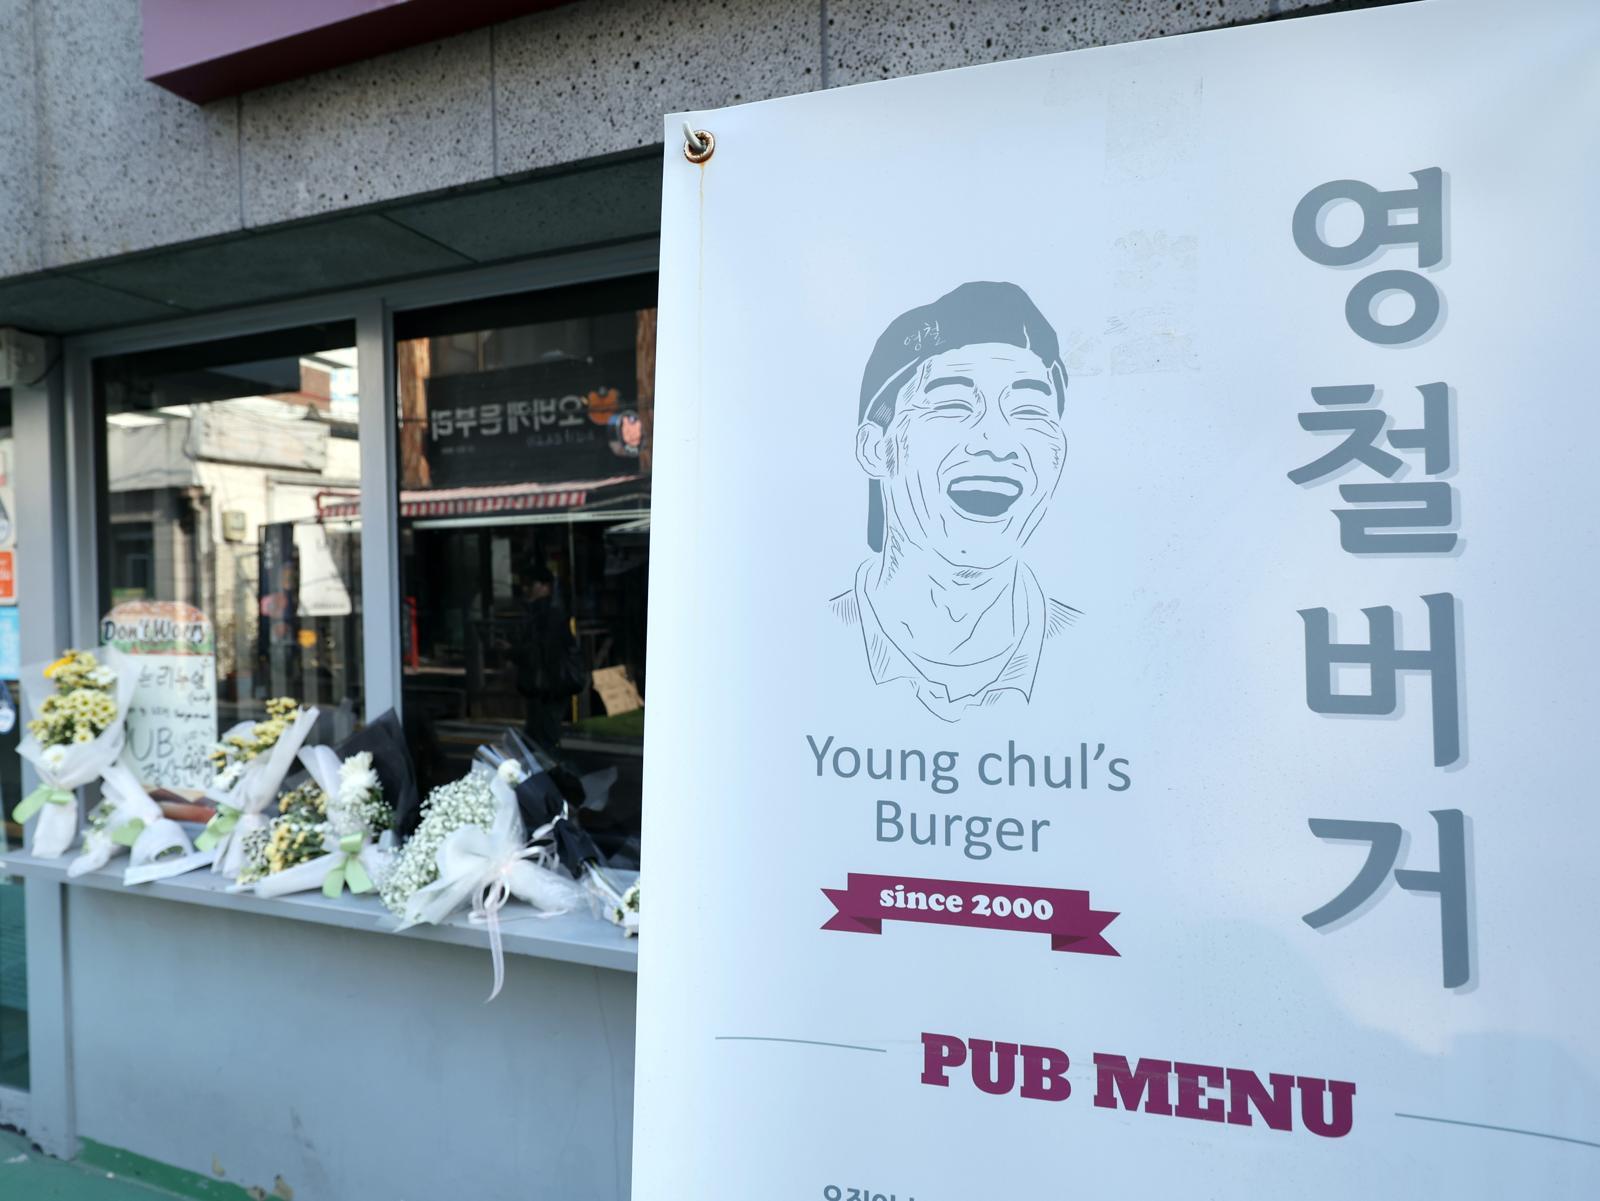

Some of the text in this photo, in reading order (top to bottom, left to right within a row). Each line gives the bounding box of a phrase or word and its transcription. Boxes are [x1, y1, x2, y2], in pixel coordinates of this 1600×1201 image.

[1287, 166, 1474, 990] 영철버거
[805, 734, 1132, 795] Young chul’s
[875, 799, 1051, 860] Burger
[879, 884, 1055, 921] since 2000
[920, 1031, 1357, 1139] PUB MENU
